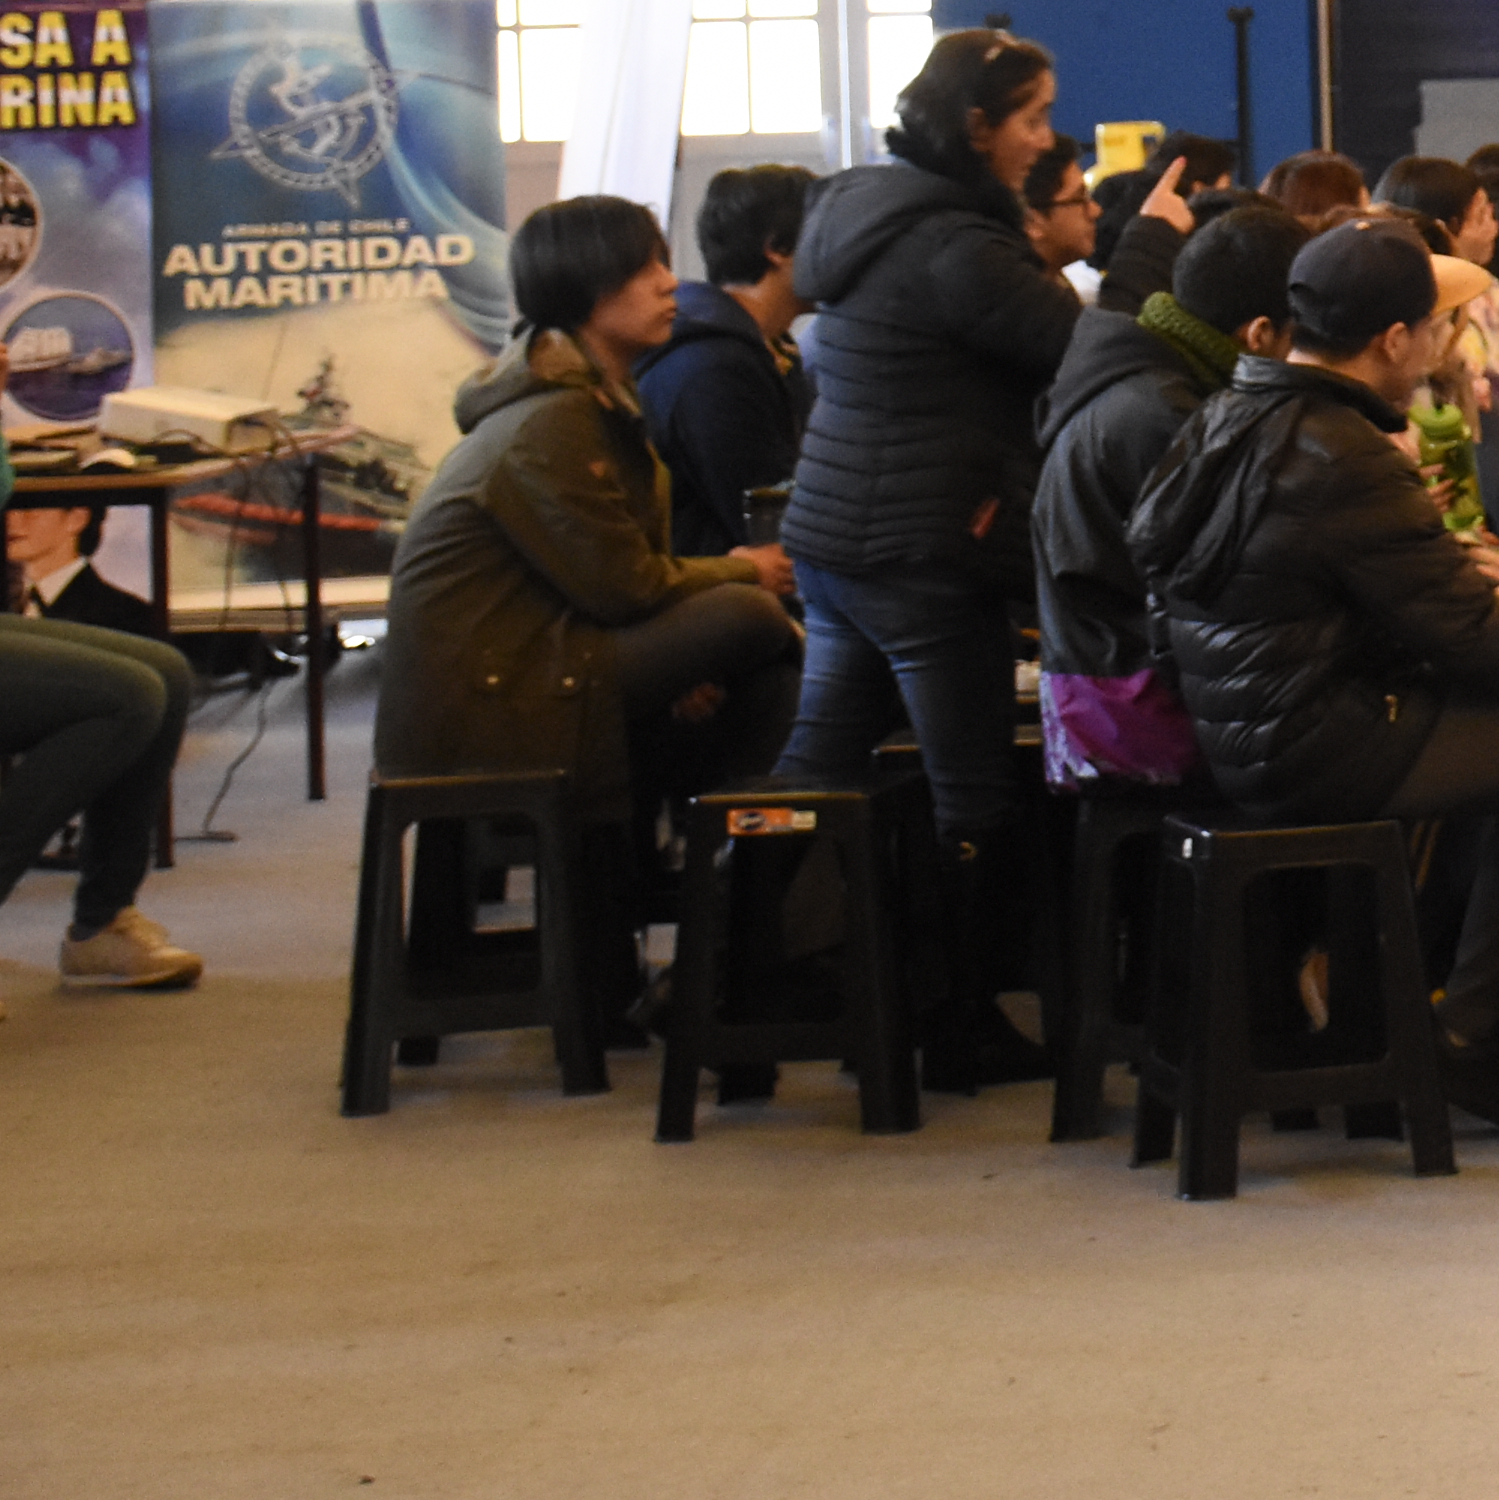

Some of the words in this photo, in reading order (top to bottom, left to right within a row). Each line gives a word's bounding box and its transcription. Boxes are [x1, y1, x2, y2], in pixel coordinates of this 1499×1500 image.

[90, 8, 133, 67] A
[314, 220, 343, 235] DE
[348, 217, 410, 235] CHILE
[162, 233, 476, 277] AUTORIDAD
[183, 268, 450, 311] MARITIMA
